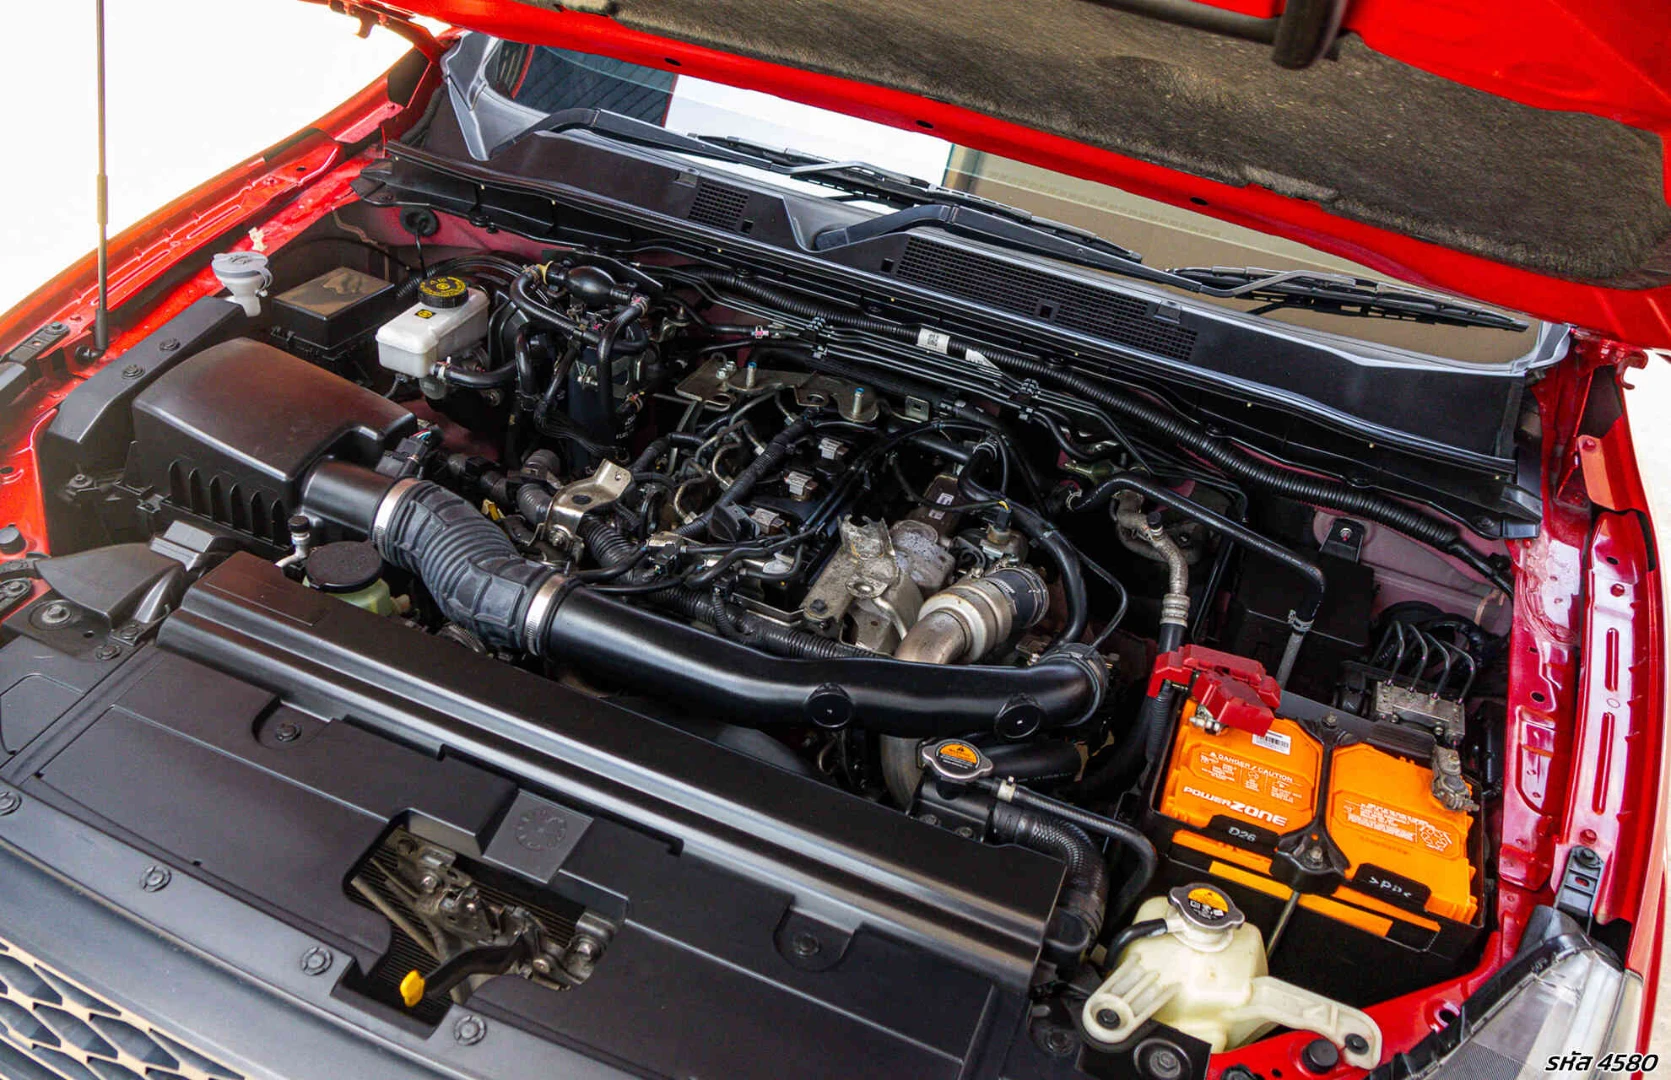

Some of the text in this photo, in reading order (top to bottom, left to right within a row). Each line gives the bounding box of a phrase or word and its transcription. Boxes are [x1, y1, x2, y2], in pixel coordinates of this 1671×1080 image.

[1218, 754, 1250, 769] DANGER
[1258, 767, 1293, 783] CAUTION
[1228, 826, 1257, 842] D26
